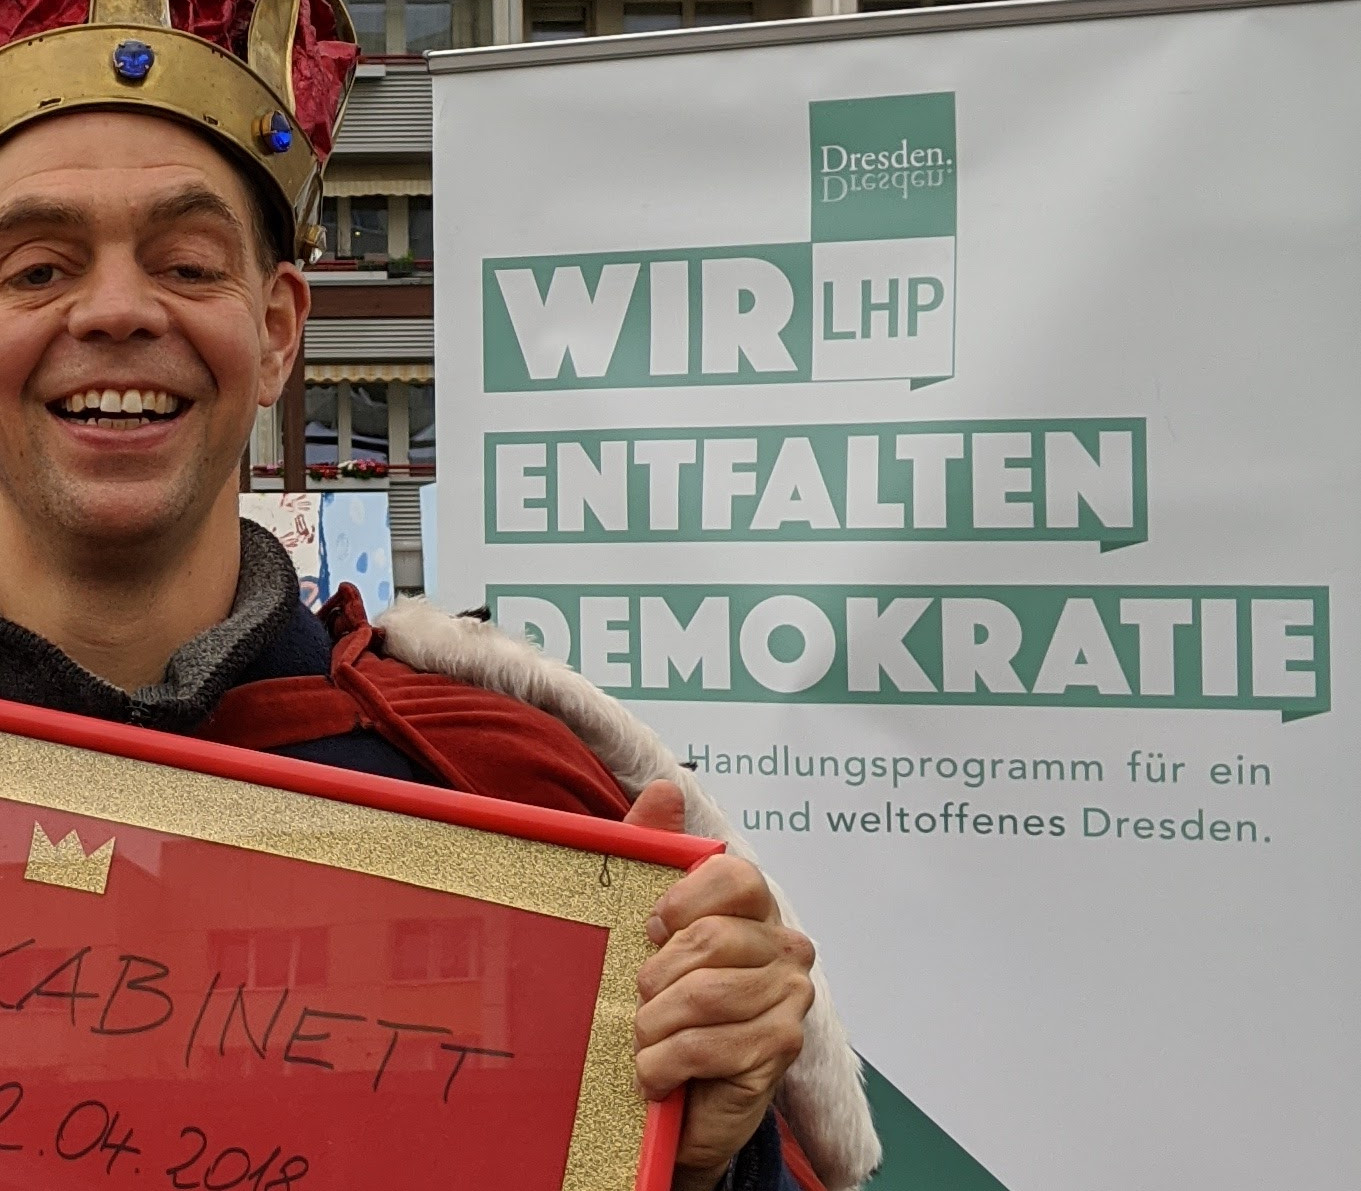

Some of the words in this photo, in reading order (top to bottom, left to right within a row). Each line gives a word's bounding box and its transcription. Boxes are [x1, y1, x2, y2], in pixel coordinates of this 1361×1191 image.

[821, 138, 953, 173] Dresden.
[495, 257, 799, 381] WIR
[823, 276, 945, 341] LHP
[496, 431, 1135, 532] ENTFALTEN
[496, 594, 1317, 697] DEMOKRATIE
[688, 744, 1104, 788] Handlungsprogramm
[1127, 750, 1185, 783] für
[1210, 755, 1272, 785] ein
[743, 801, 811, 832] und
[827, 801, 1067, 837] weltoffenes
[1083, 807, 1272, 843] Dresden.
